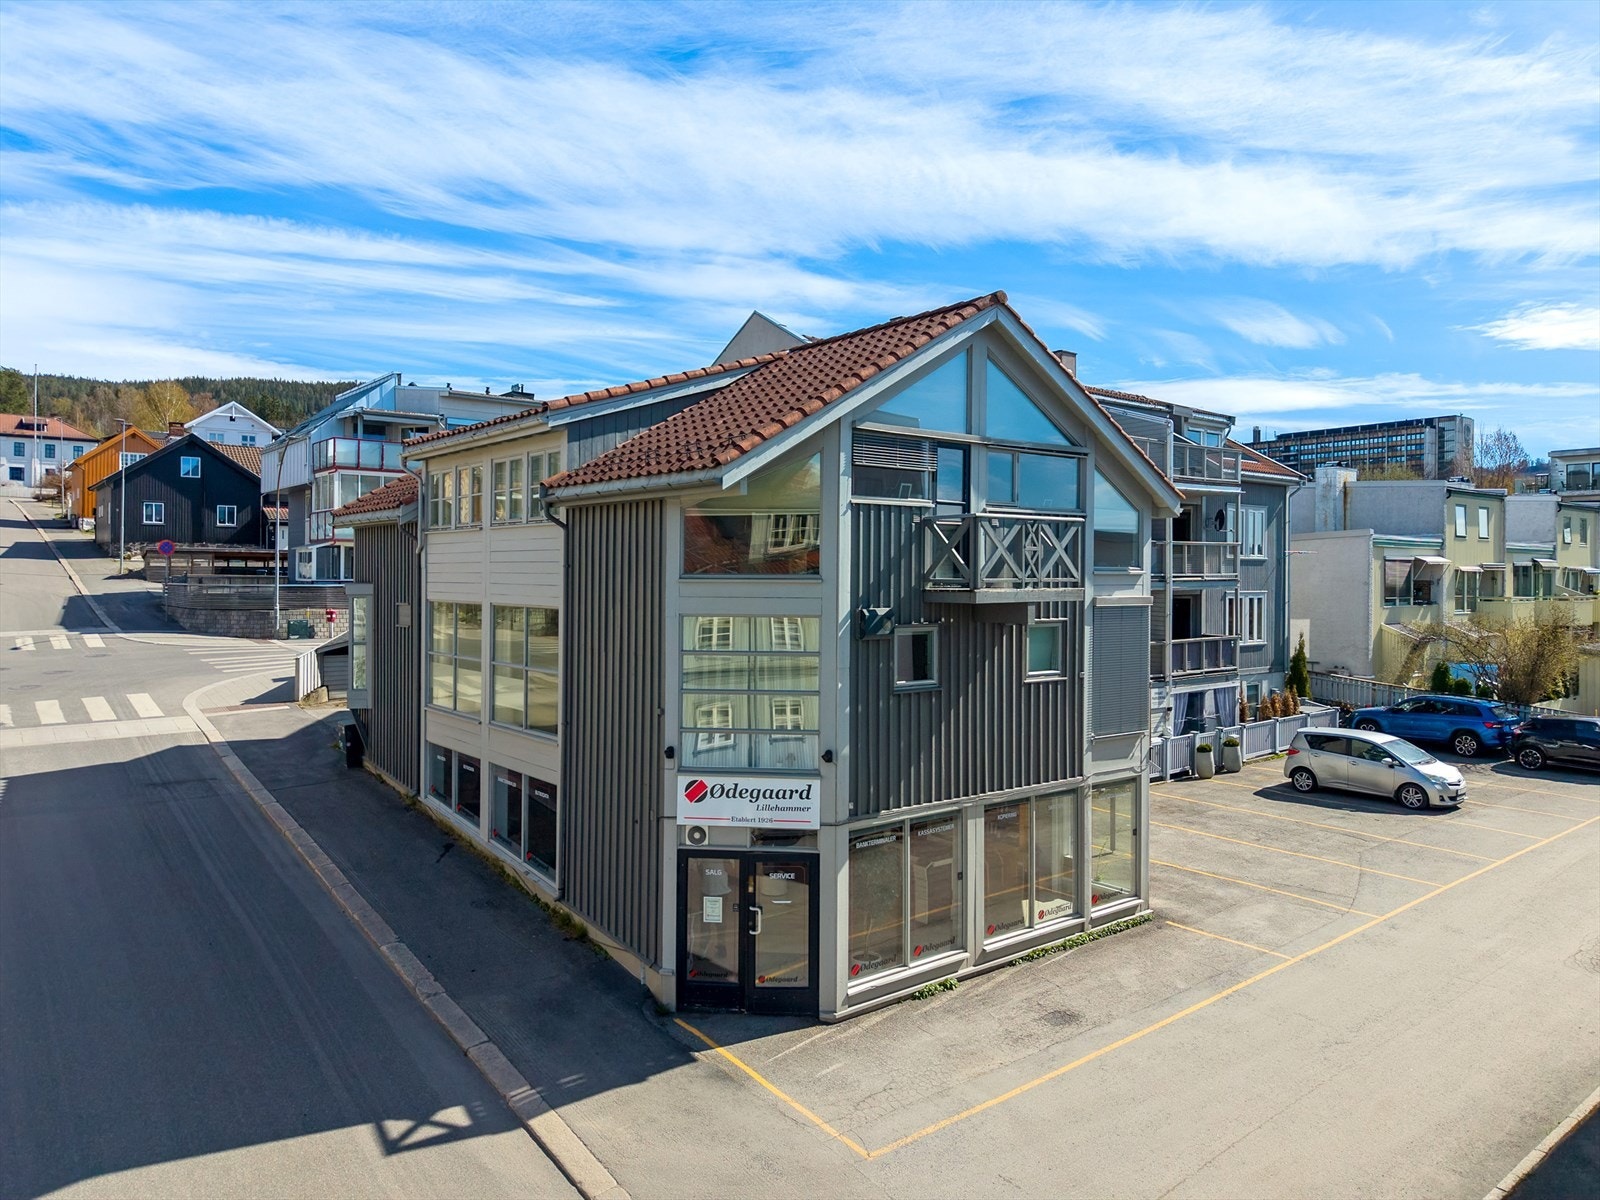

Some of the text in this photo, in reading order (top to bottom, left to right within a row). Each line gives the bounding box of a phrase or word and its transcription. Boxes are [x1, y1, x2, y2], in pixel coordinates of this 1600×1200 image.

[709, 783, 812, 803] Ødegaard
[756, 804, 811, 812] Lillehammer
[769, 872, 796, 880] SERVICE
